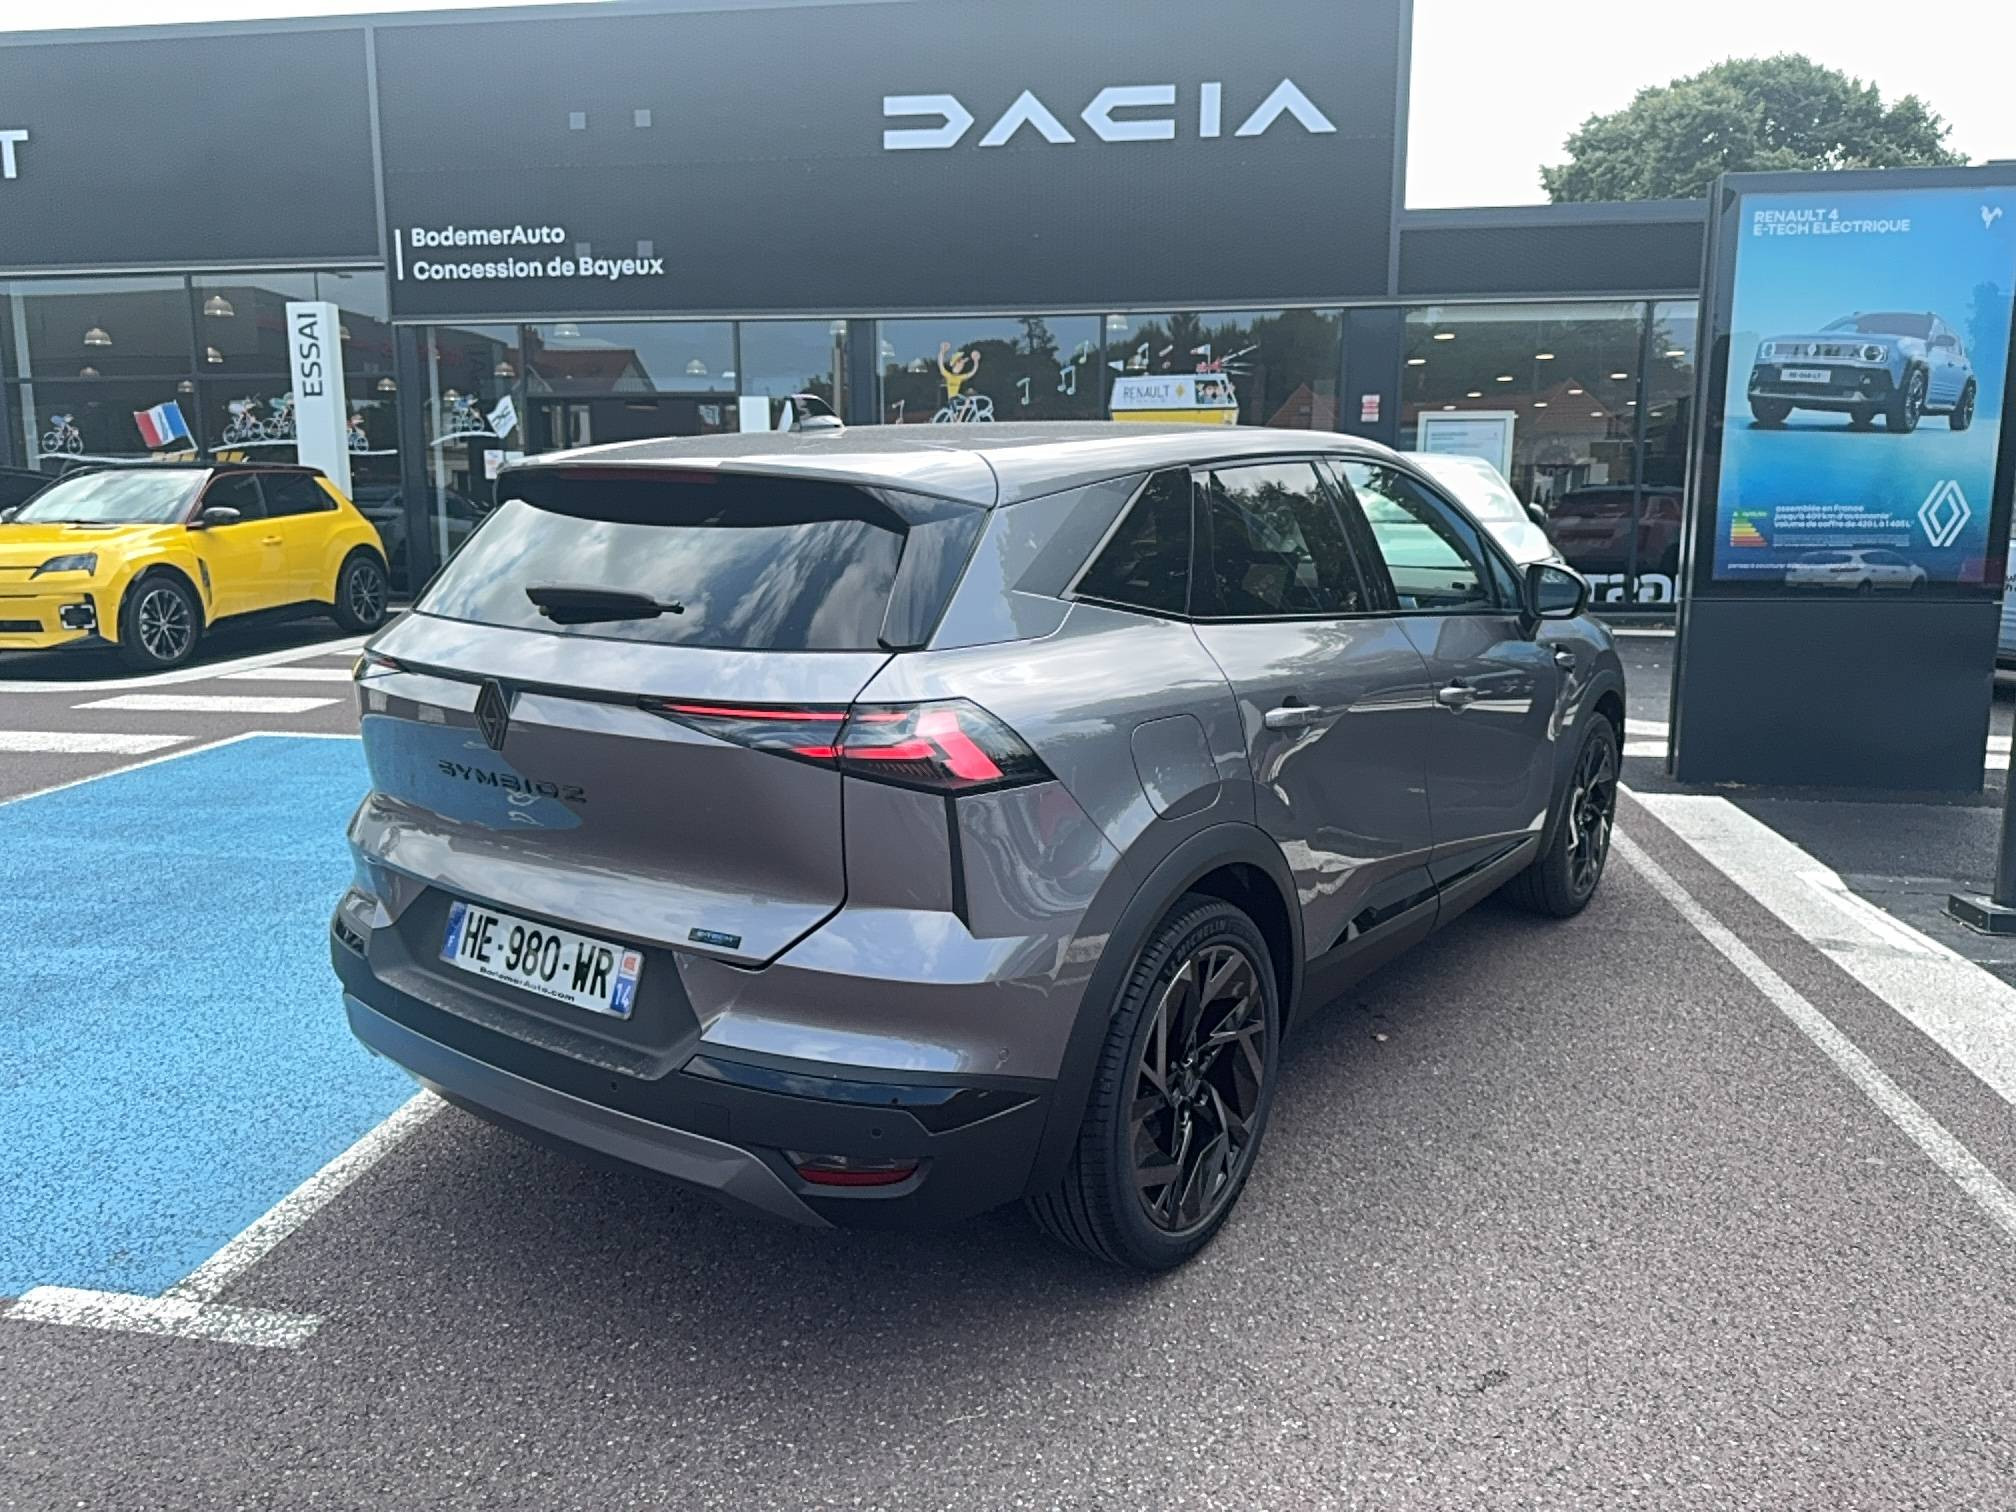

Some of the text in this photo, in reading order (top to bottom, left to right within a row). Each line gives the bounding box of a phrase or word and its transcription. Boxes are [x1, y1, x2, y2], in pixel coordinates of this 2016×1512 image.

[883, 77, 1338, 150] DACIA
[1754, 208, 1839, 224] RENAULT 4
[411, 225, 566, 247] BodemerAuto
[1753, 222, 1809, 236] E-TECH
[413, 256, 664, 280] Concession de Bayeux
[297, 313, 324, 399] ESSAI
[1123, 384, 1170, 400] RENAULT
[460, 911, 614, 999] HE-980-WR
[614, 981, 631, 1014] 14
